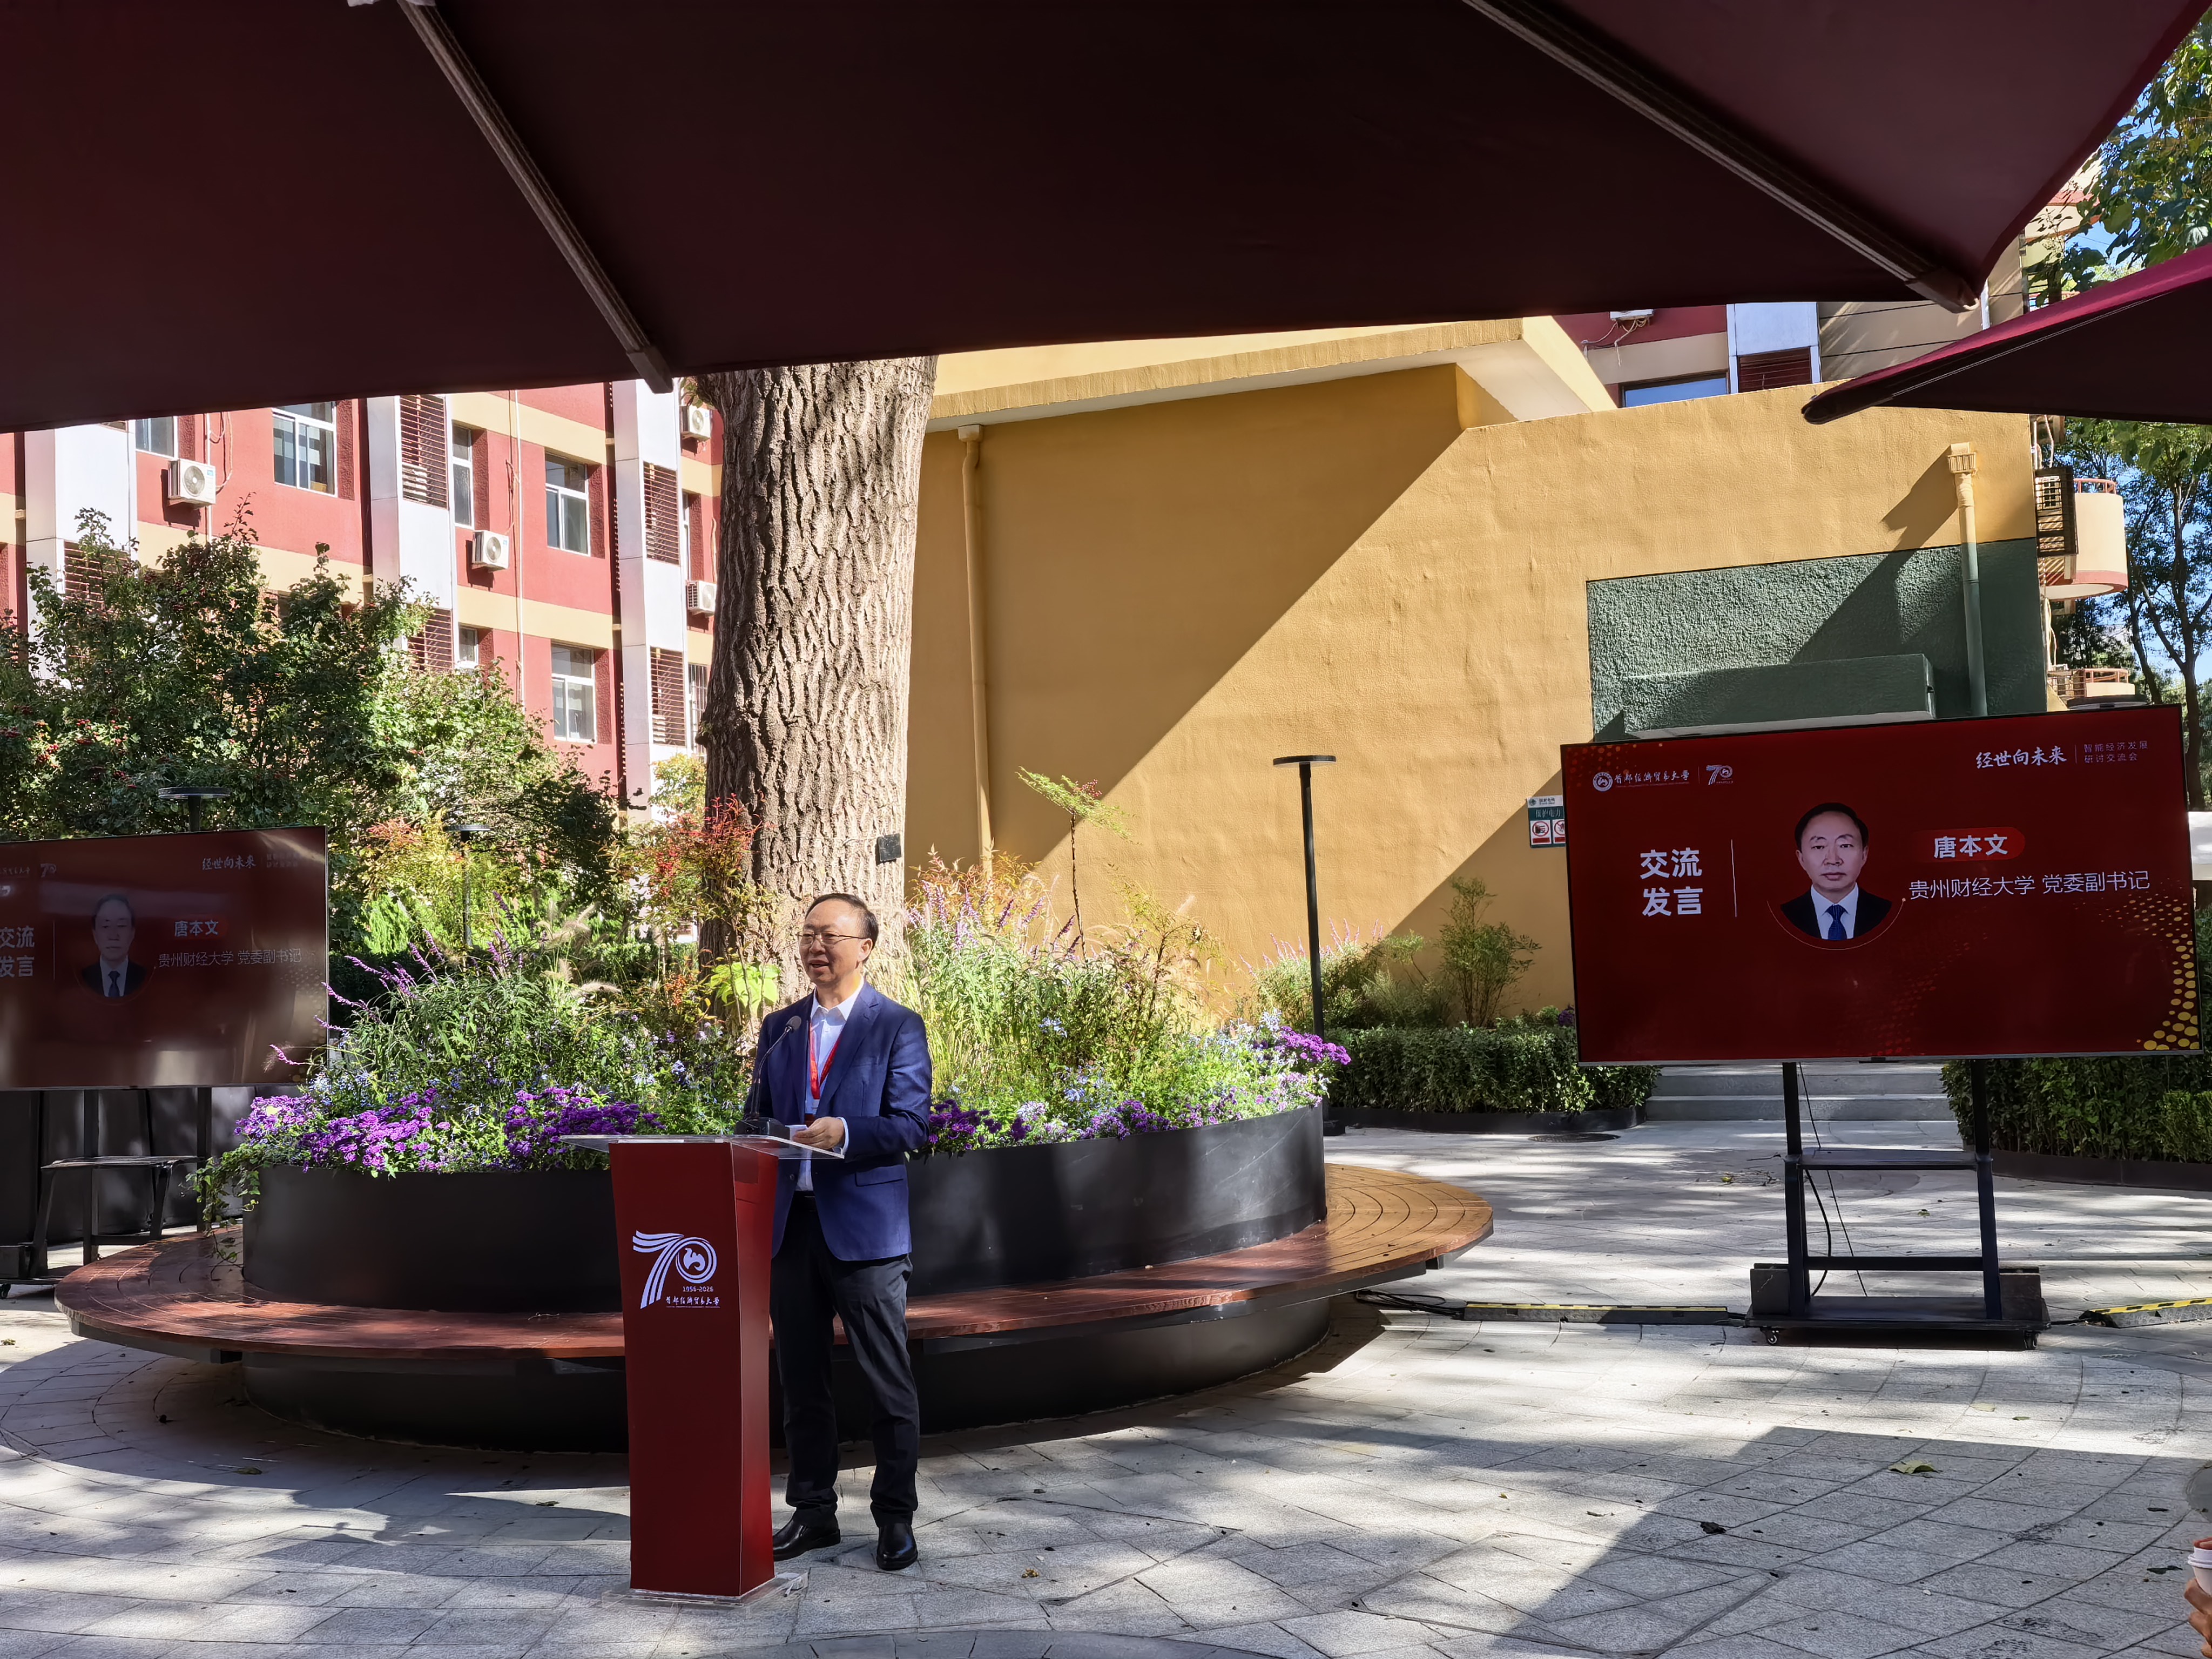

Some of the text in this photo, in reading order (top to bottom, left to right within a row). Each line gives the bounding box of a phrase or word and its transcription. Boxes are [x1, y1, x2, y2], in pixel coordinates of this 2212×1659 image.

[1975, 745, 2067, 769] 经世向未来
[2084, 740, 2148, 753] 智能经济发展
[2084, 752, 2138, 764] 研讨交流会
[1934, 834, 2008, 859] 唐本文
[202, 854, 256, 870] 经世向未来
[1640, 847, 1702, 879] 交流
[1908, 871, 2150, 900] 贵州财经大学 党委副书记
[1642, 886, 1703, 916] 发言
[0, 925, 35, 948] 交流
[174, 920, 219, 937] 唐本文
[0, 955, 35, 977] 发言
[159, 948, 302, 967] 贵州财经大学 党委副书记
